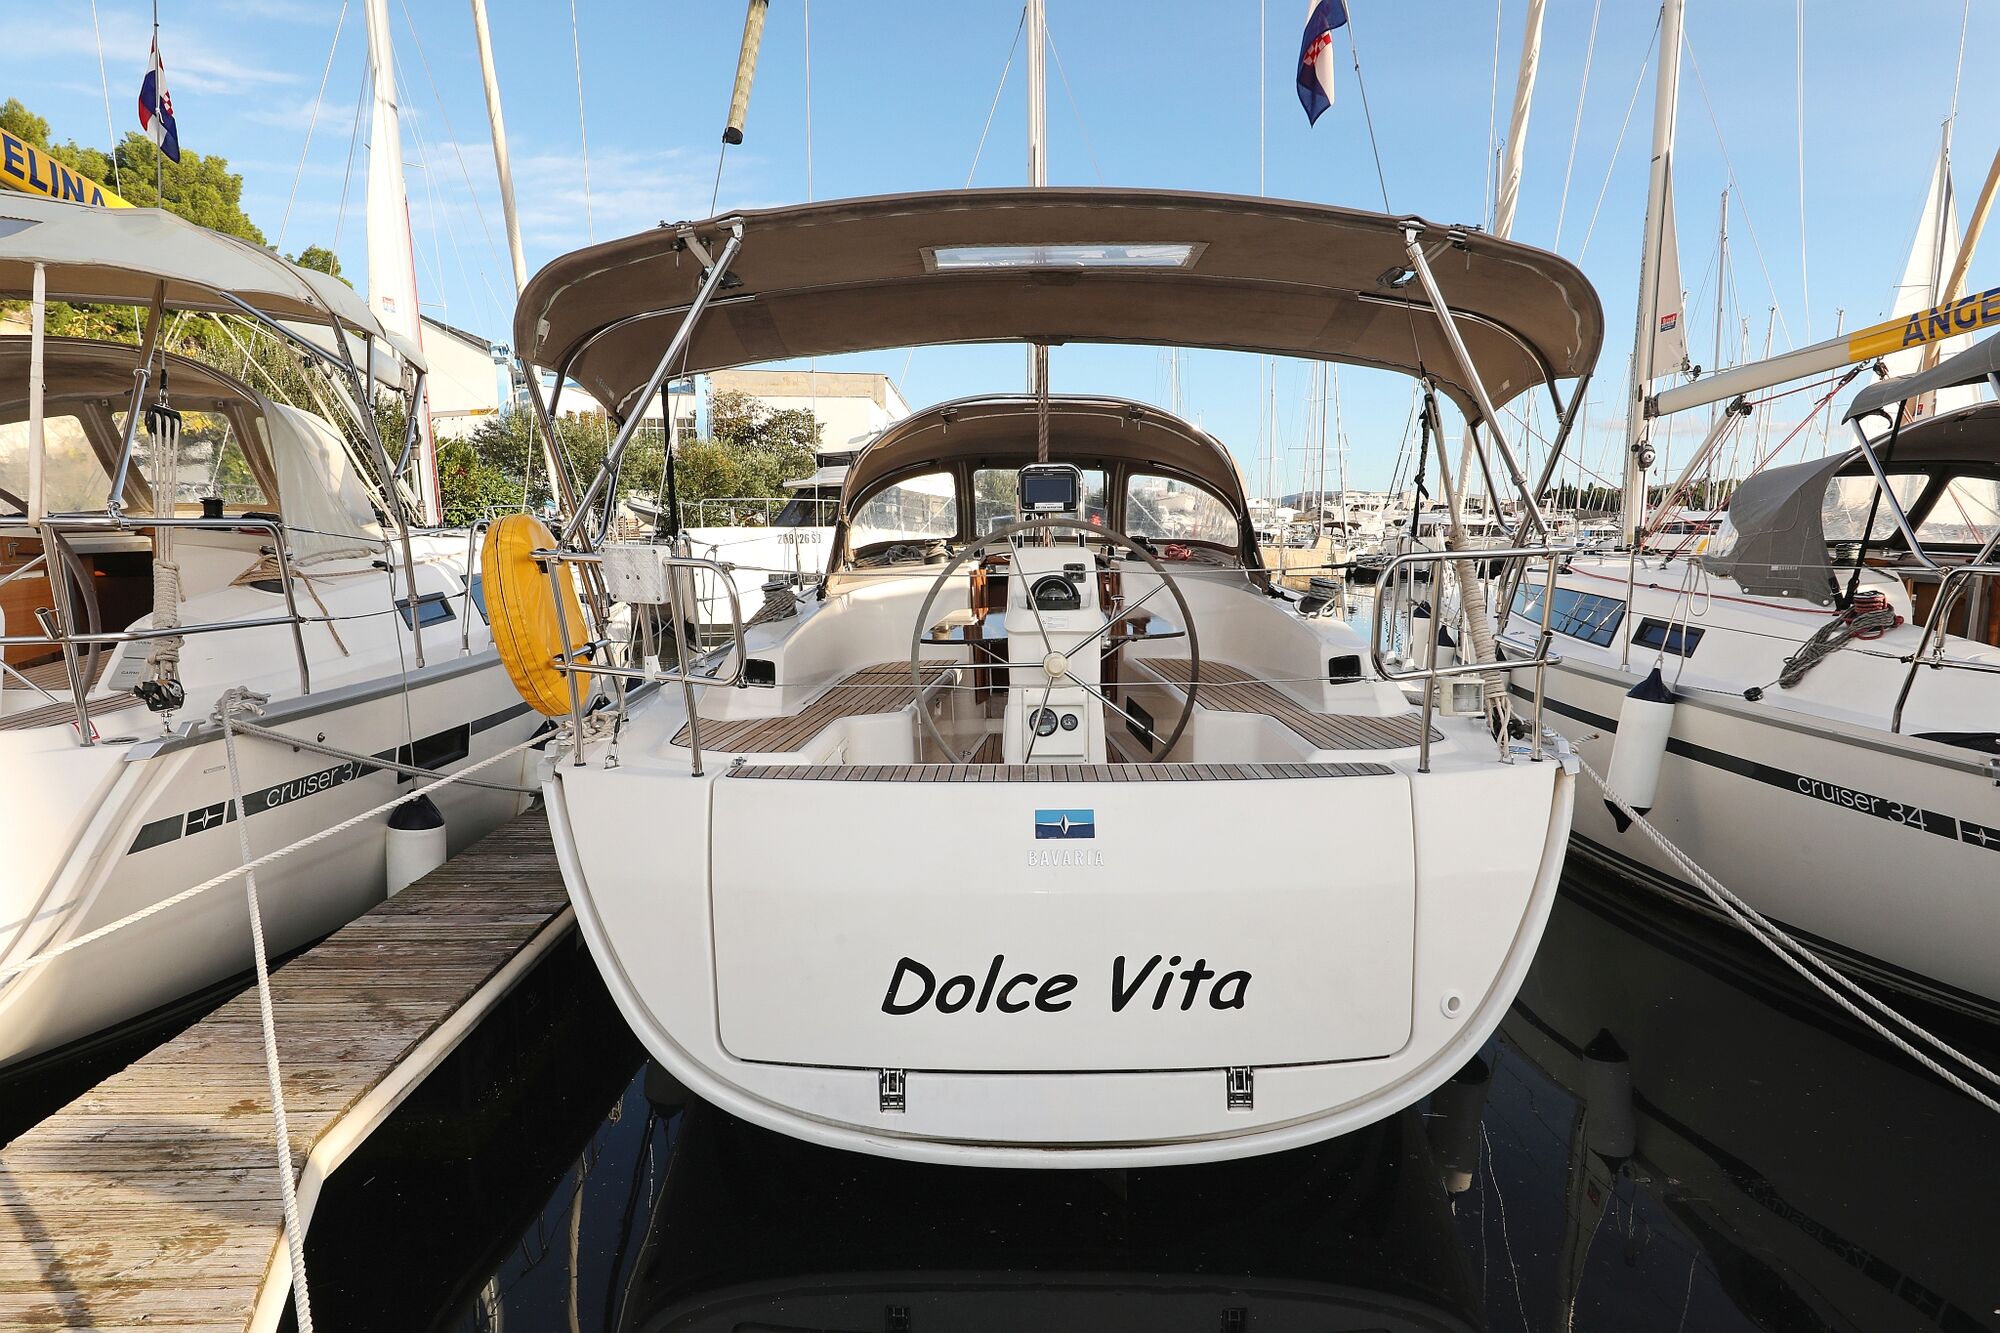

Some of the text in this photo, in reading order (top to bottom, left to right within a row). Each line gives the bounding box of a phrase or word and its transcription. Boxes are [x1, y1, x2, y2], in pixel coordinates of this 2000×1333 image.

[266, 767, 339, 808] cruiser
[1797, 777, 1928, 832] cruiser 34
[1028, 849, 1104, 867] BAVARIA
[881, 953, 1253, 1016] Dolce Vita
